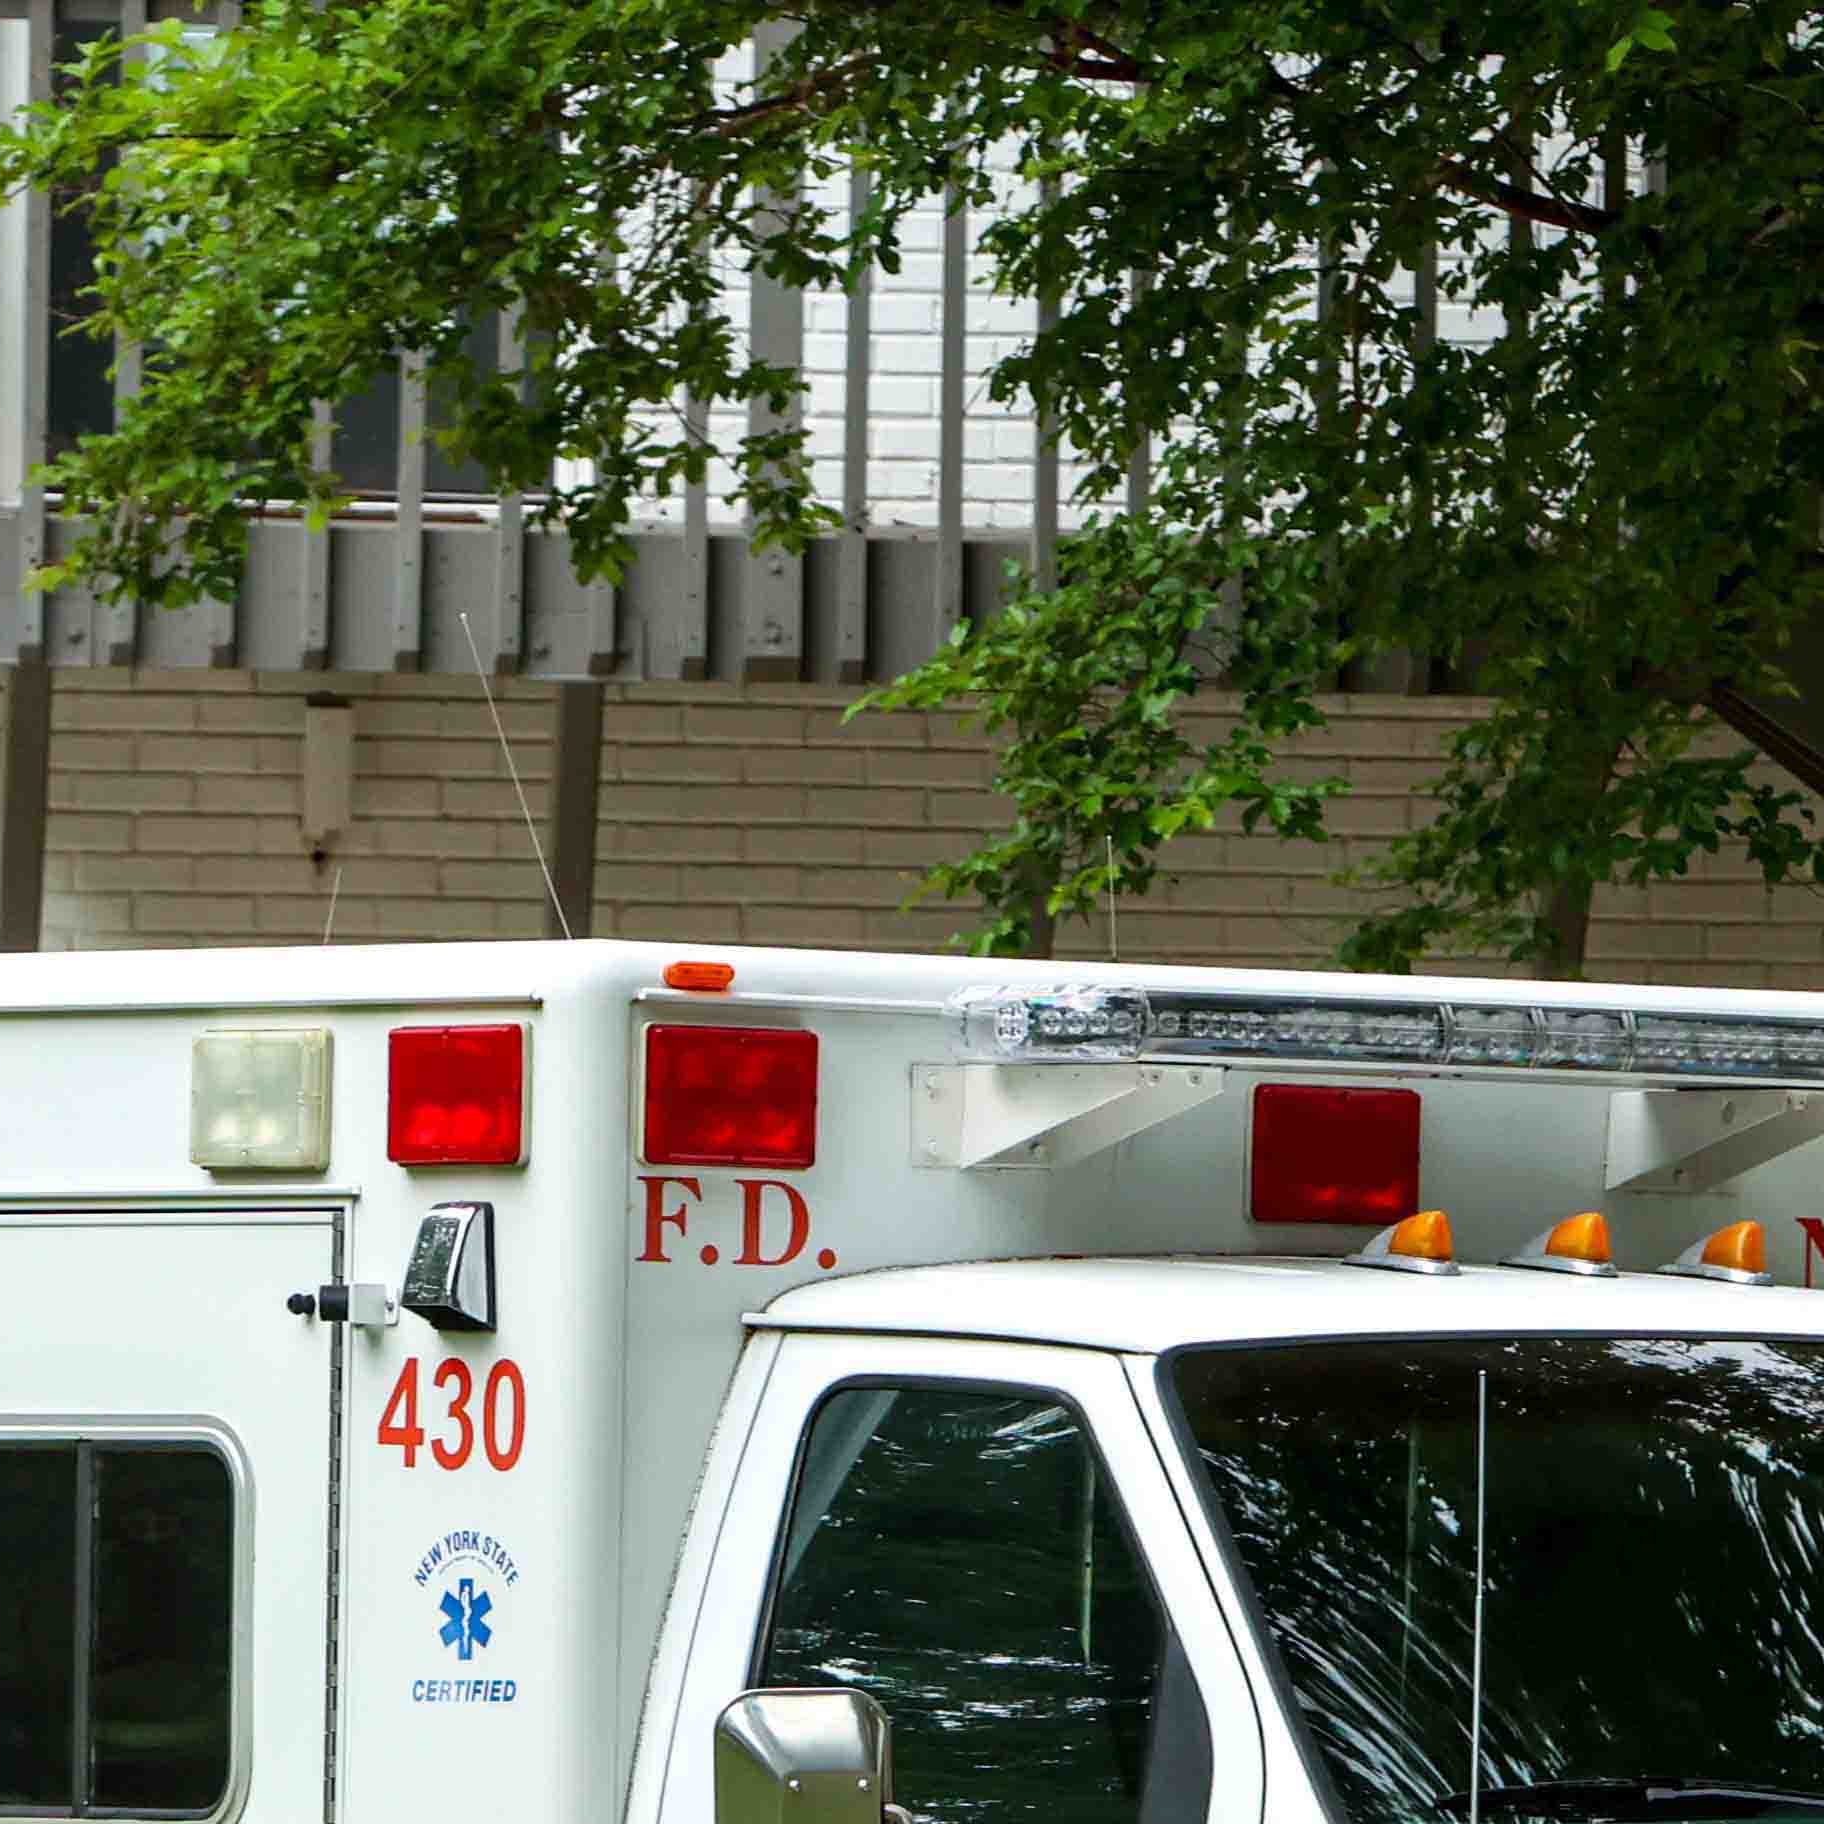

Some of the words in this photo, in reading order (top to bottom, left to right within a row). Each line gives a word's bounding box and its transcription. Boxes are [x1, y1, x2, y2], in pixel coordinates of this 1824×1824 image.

[635, 1176, 836, 1270] F.D.
[377, 1358, 526, 1471] 430
[414, 1543, 442, 1587] NEW
[443, 1530, 480, 1555] YORK
[482, 1536, 520, 1587] STATE
[412, 1679, 517, 1702] CERTIFIED
